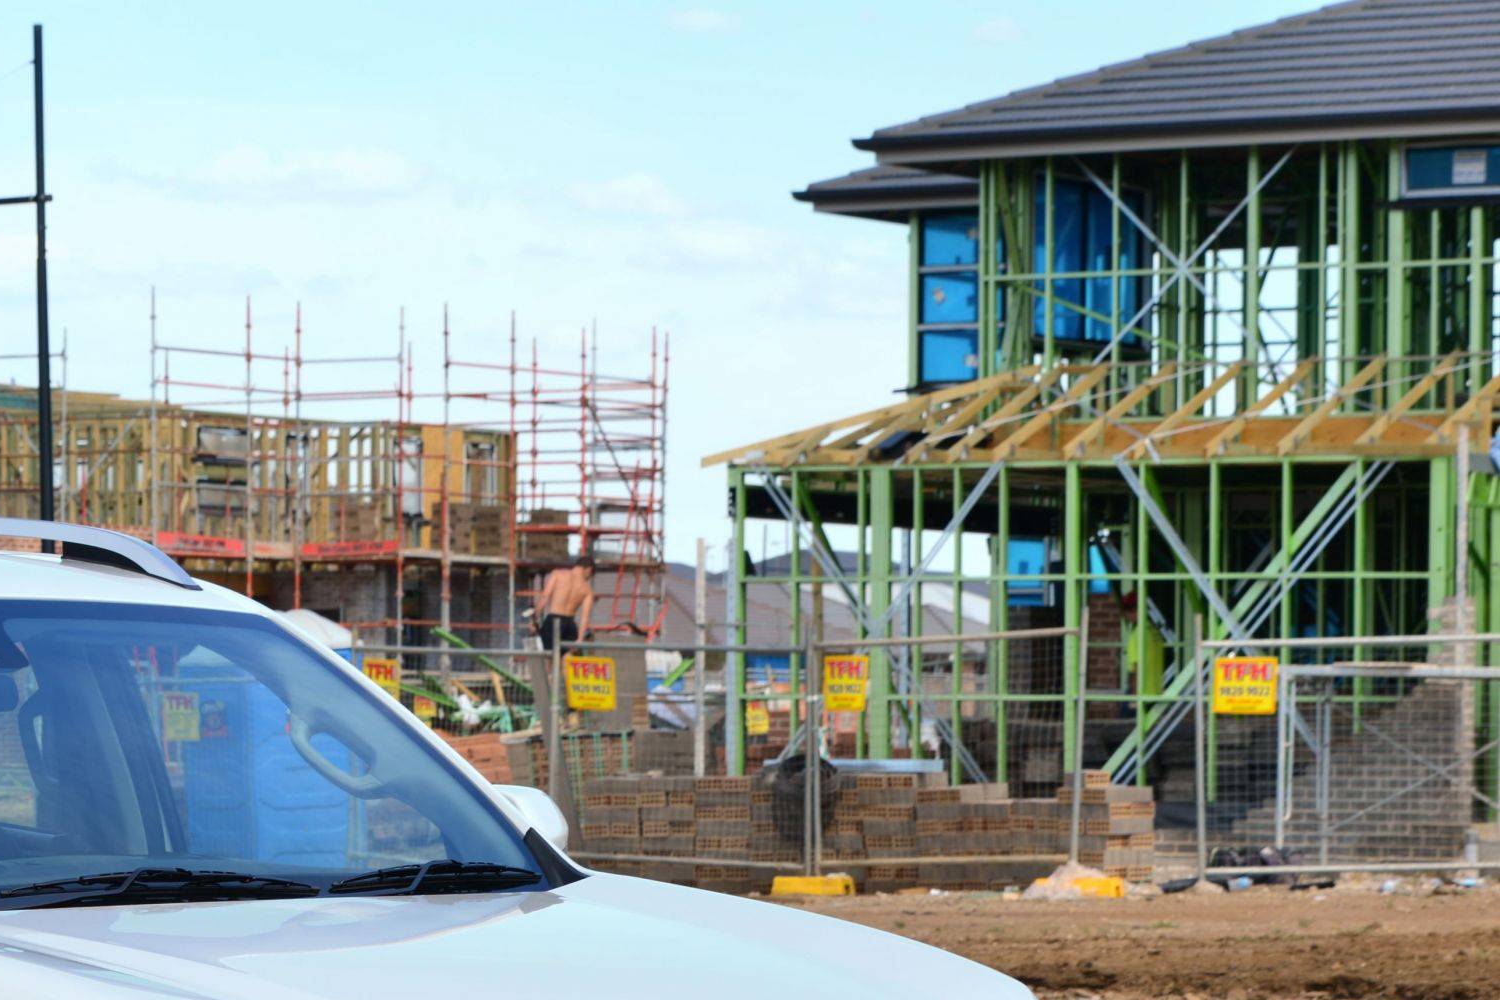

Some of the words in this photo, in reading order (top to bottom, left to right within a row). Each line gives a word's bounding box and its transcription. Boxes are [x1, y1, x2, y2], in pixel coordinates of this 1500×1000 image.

[366, 662, 396, 681] TFH
[571, 662, 610, 681] TFH
[827, 660, 862, 680] TFH
[1220, 662, 1271, 681] TFH
